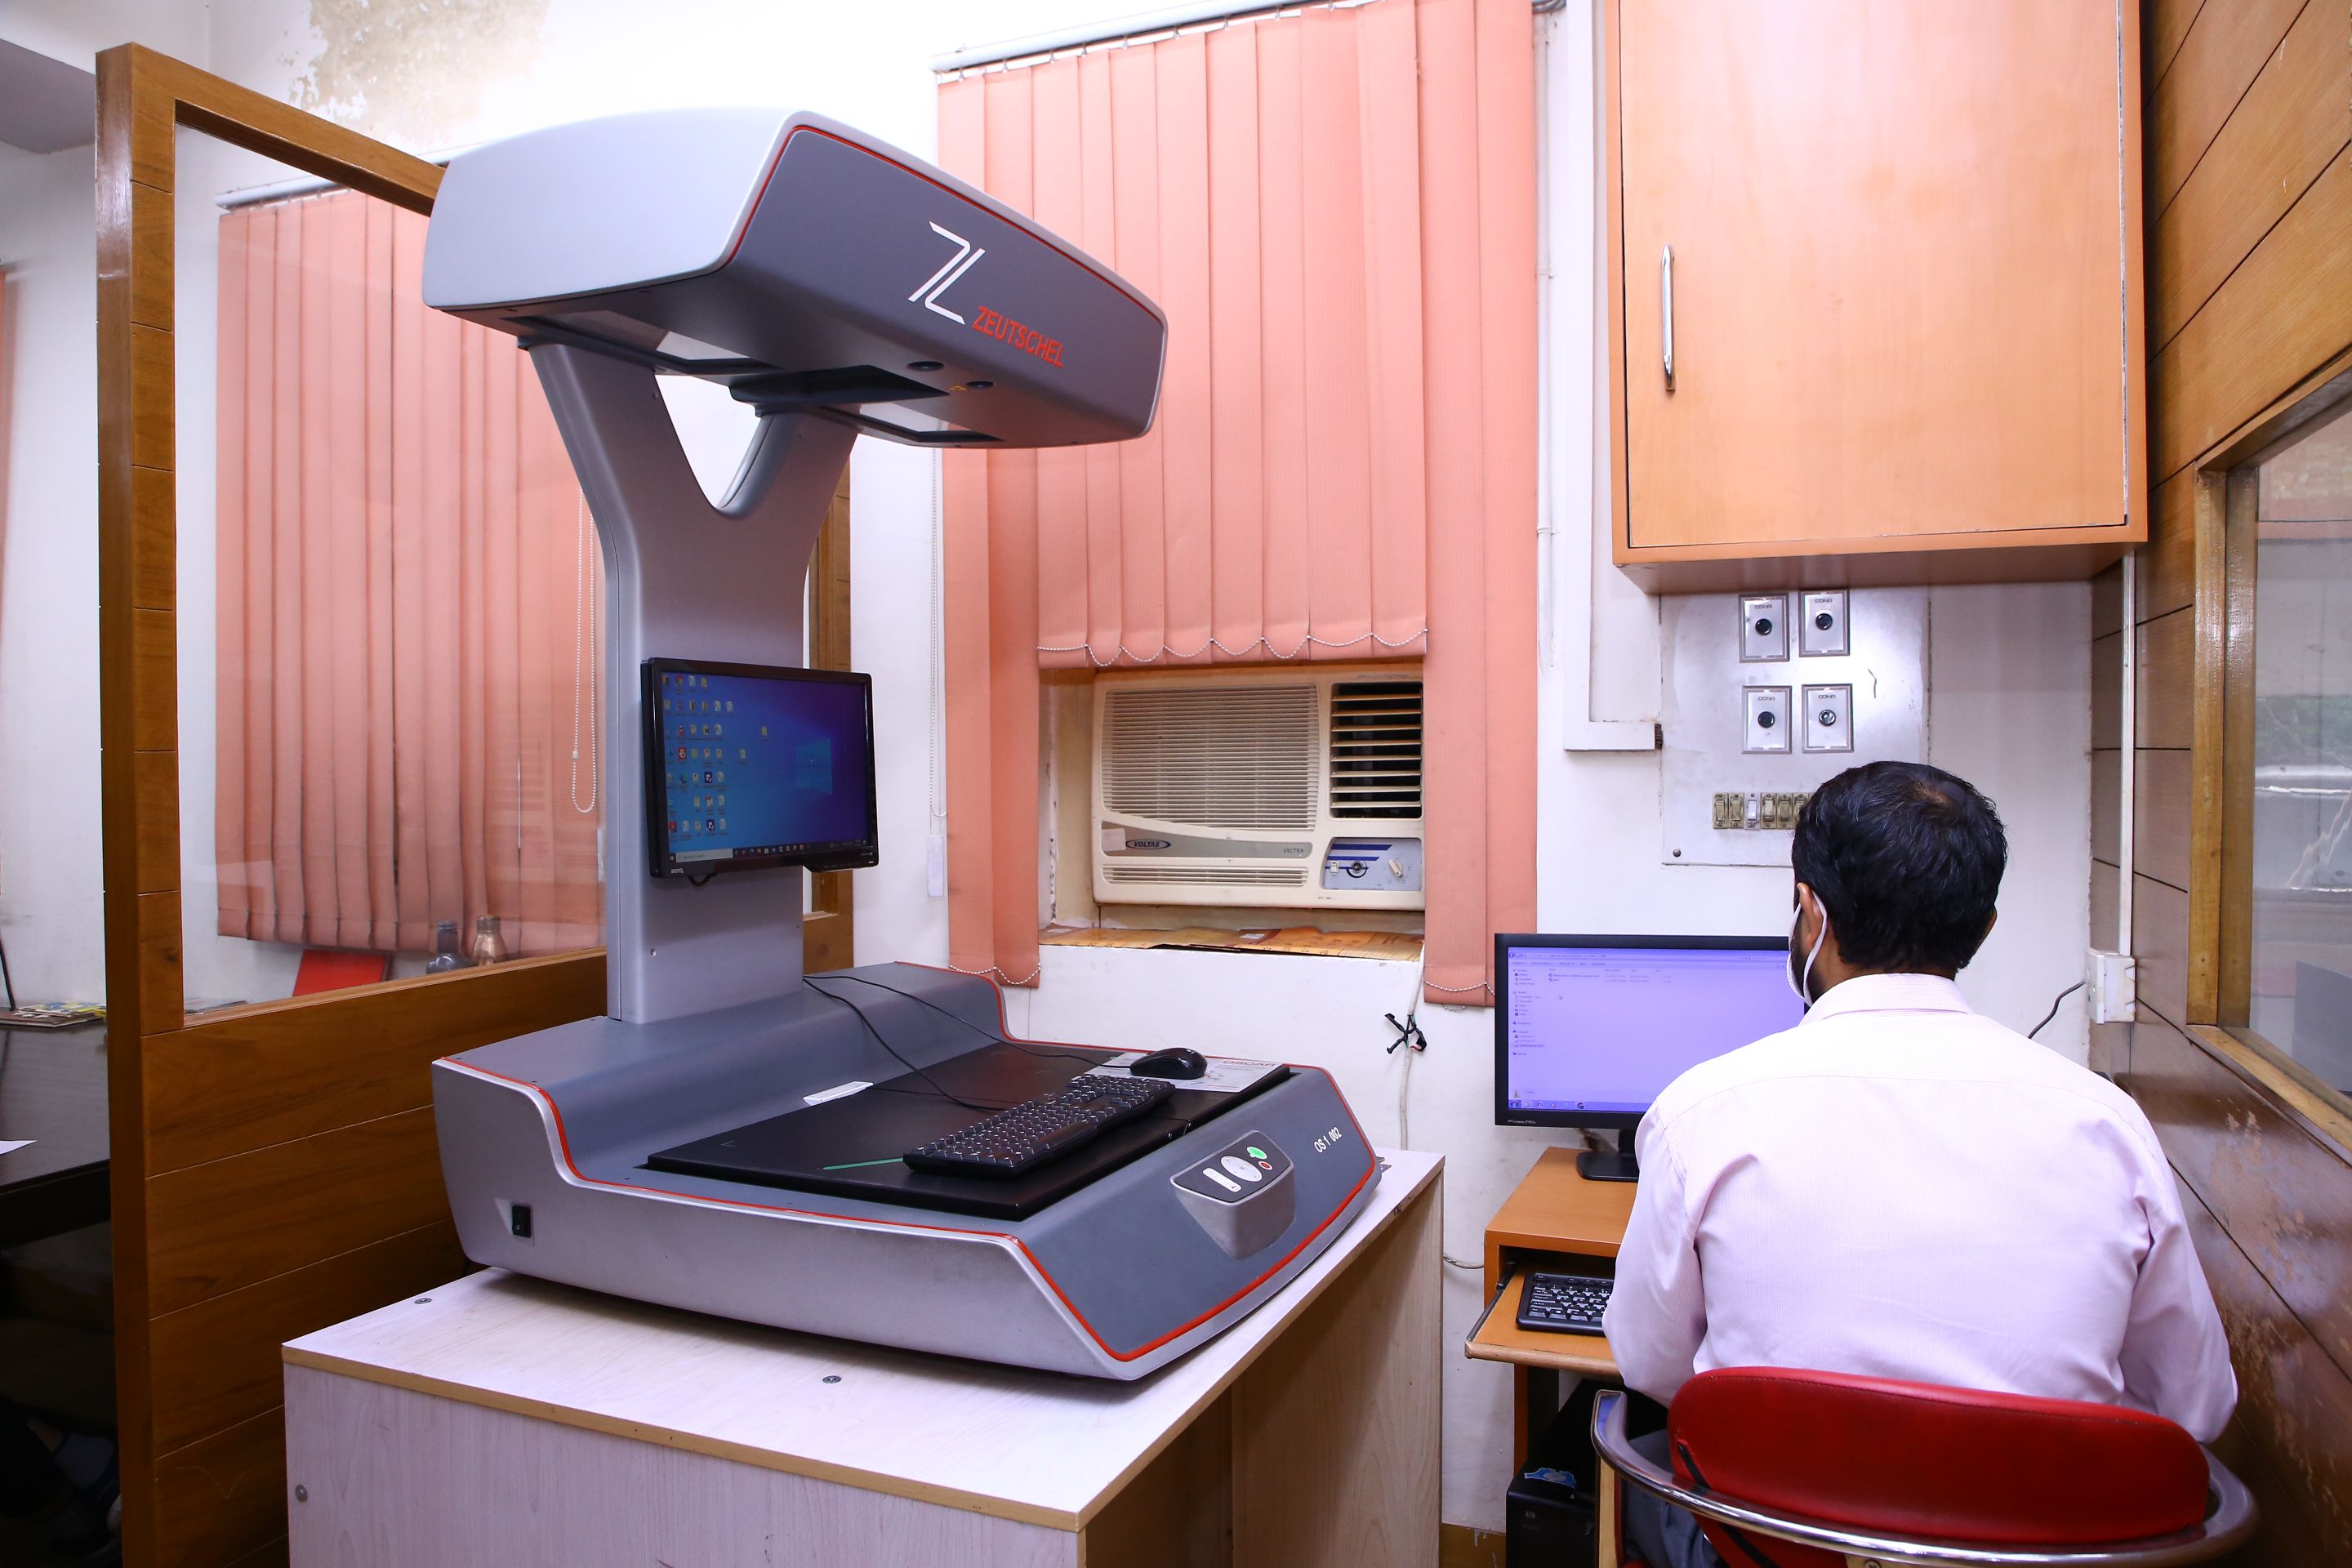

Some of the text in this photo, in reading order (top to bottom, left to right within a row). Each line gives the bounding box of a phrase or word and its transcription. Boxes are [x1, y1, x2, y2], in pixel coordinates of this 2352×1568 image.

[972, 305, 1067, 368] ZEUTSCHEL
[1314, 1126, 1343, 1153] OS 1 002
